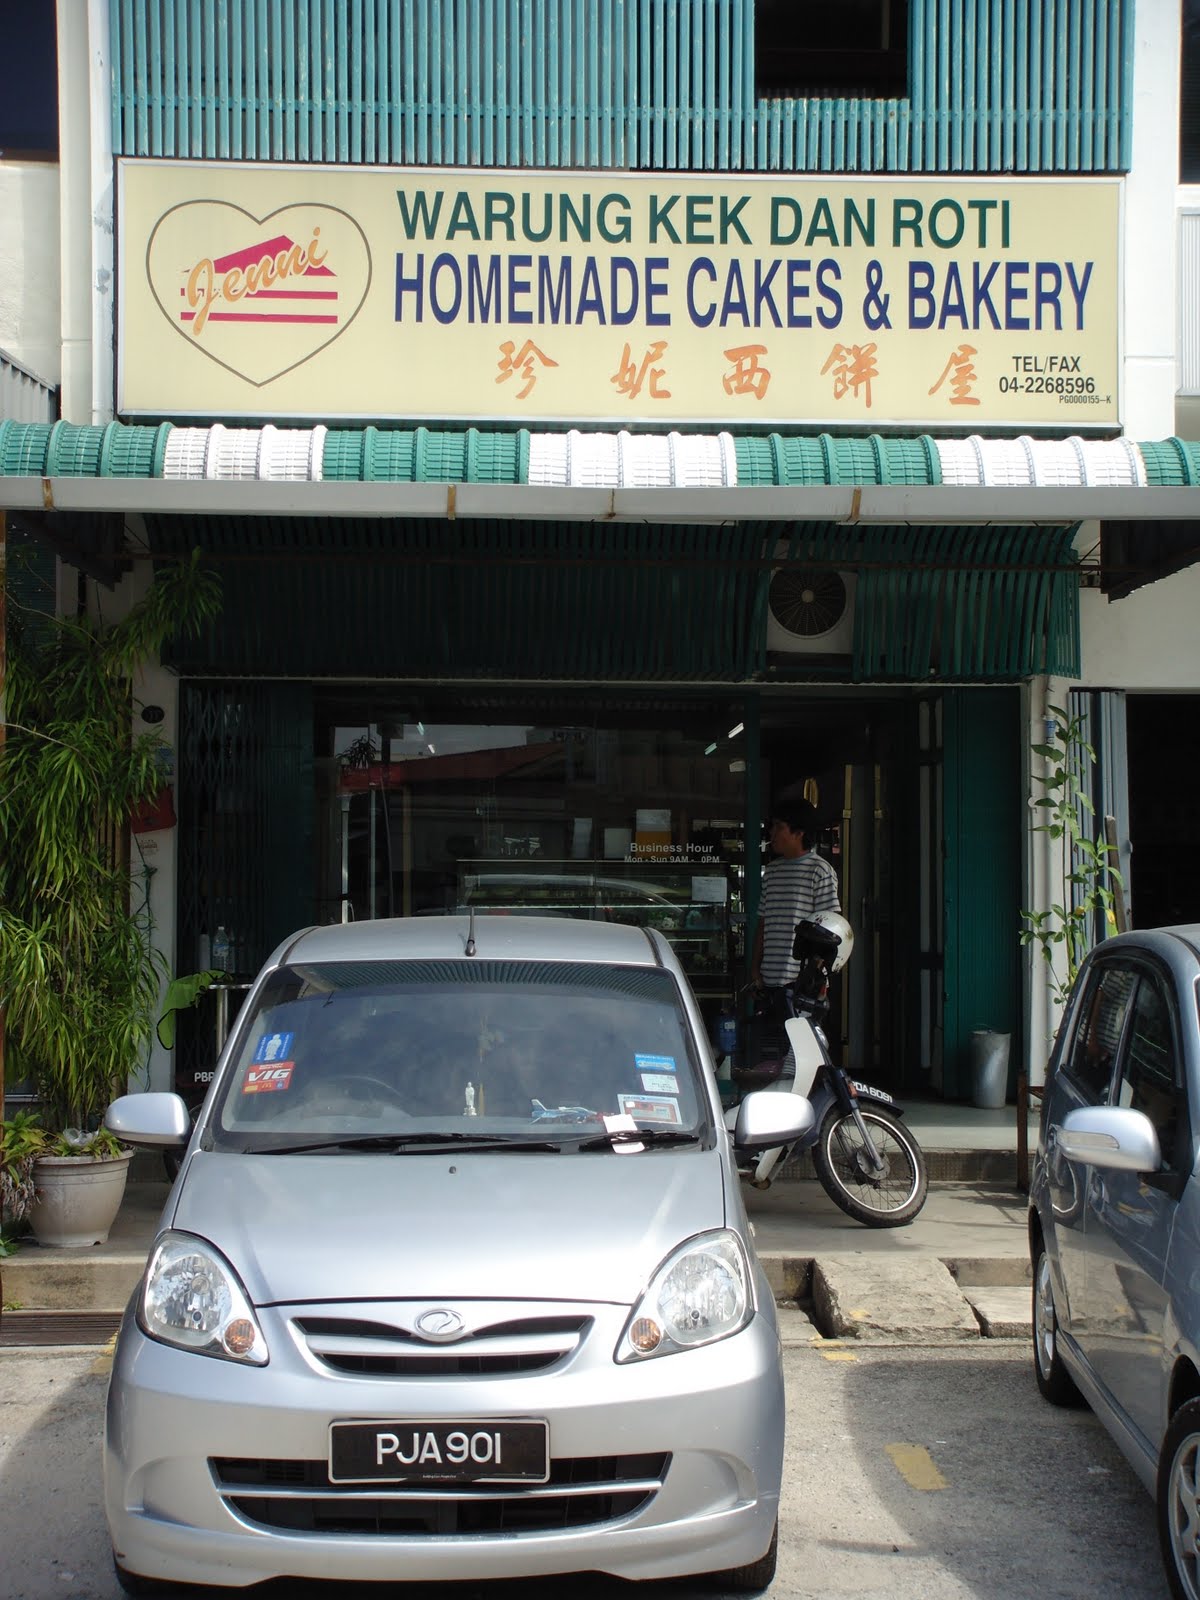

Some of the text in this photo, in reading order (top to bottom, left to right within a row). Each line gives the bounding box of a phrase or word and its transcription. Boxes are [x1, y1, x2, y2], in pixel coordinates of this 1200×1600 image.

[395, 190, 1010, 249] WARUNG KEK DAN ROTI
[187, 226, 328, 336] Jenni
[394, 252, 1094, 331] HOMEMADE CAKES & BAKERY
[1011, 355, 1081, 374] TEL/FAX
[998, 376, 1096, 394] 04-2268596
[630, 842, 714, 853] Business Hour
[624, 855, 643, 863] Mon
[650, 855, 667, 863] Sun
[669, 855, 689, 863] 9AM
[248, 1068, 291, 1082] VIG
[376, 1431, 501, 1465] PJA901
